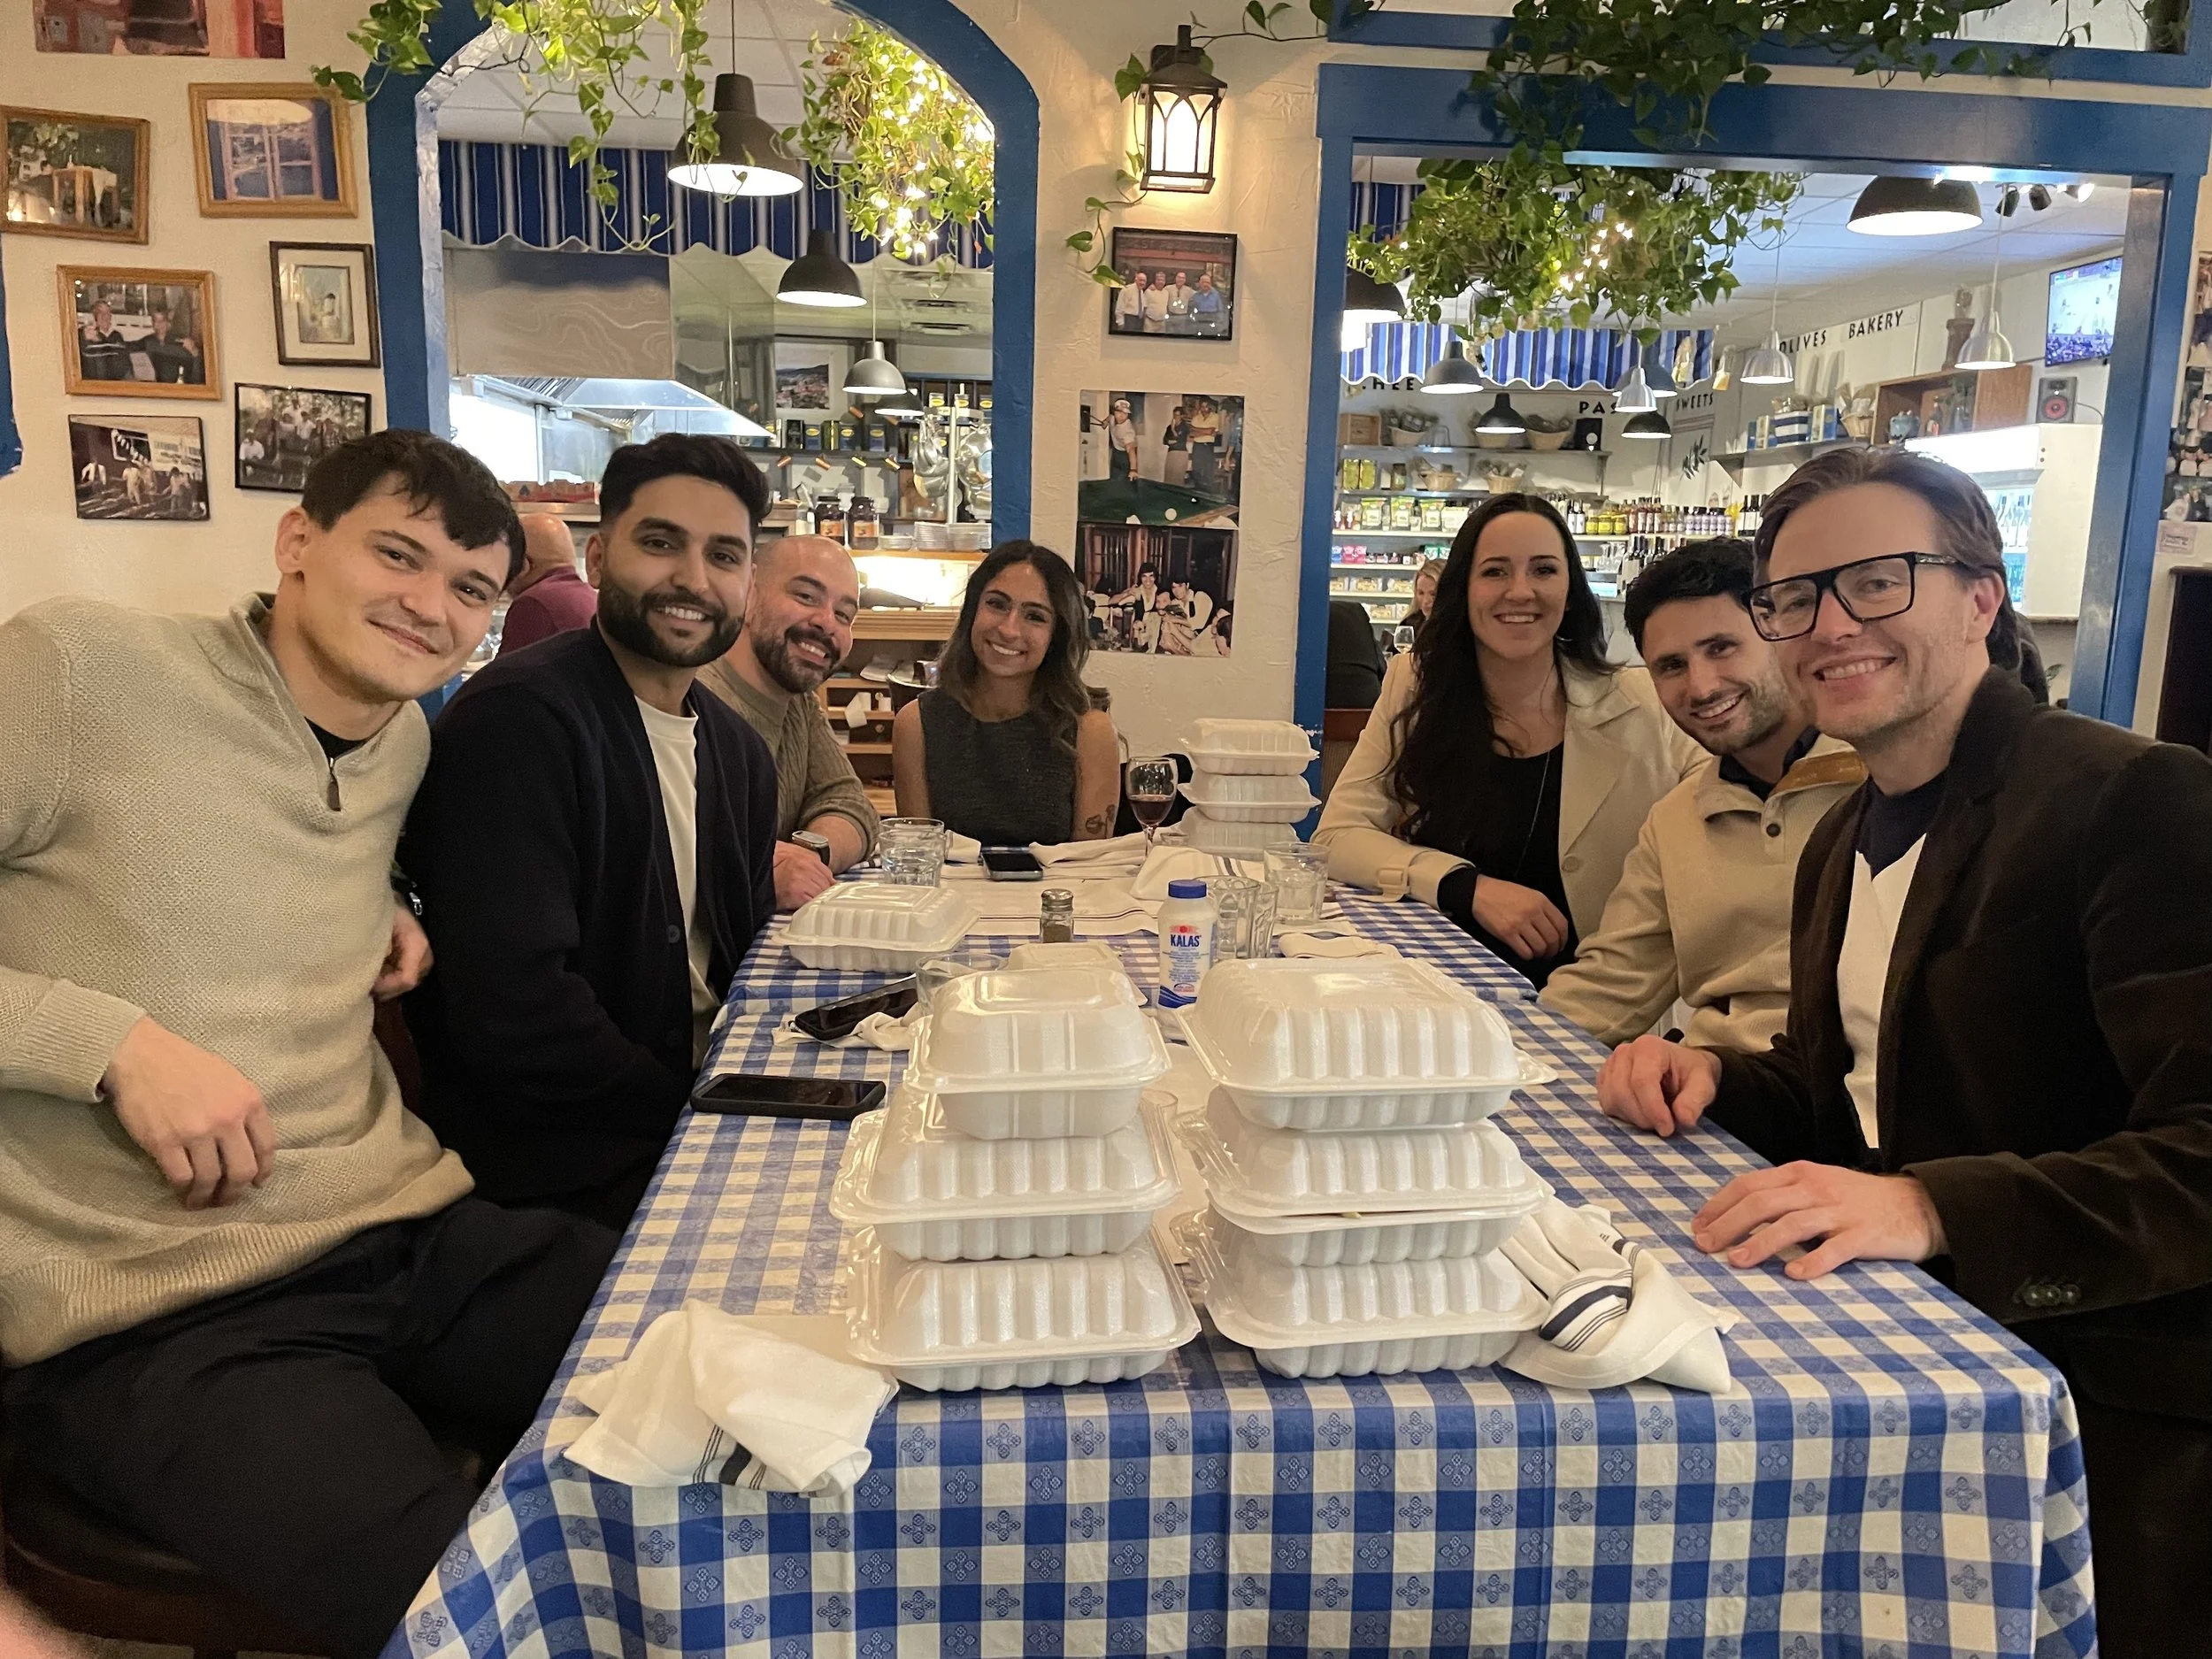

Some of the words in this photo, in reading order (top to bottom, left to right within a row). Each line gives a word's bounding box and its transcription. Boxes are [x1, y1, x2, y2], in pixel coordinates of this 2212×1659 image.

[1848, 309, 1904, 340] BAKERY
[1362, 377, 1415, 391] HEE
[1675, 392, 1714, 411] SWEETS
[1170, 933, 1201, 948] KALAS
